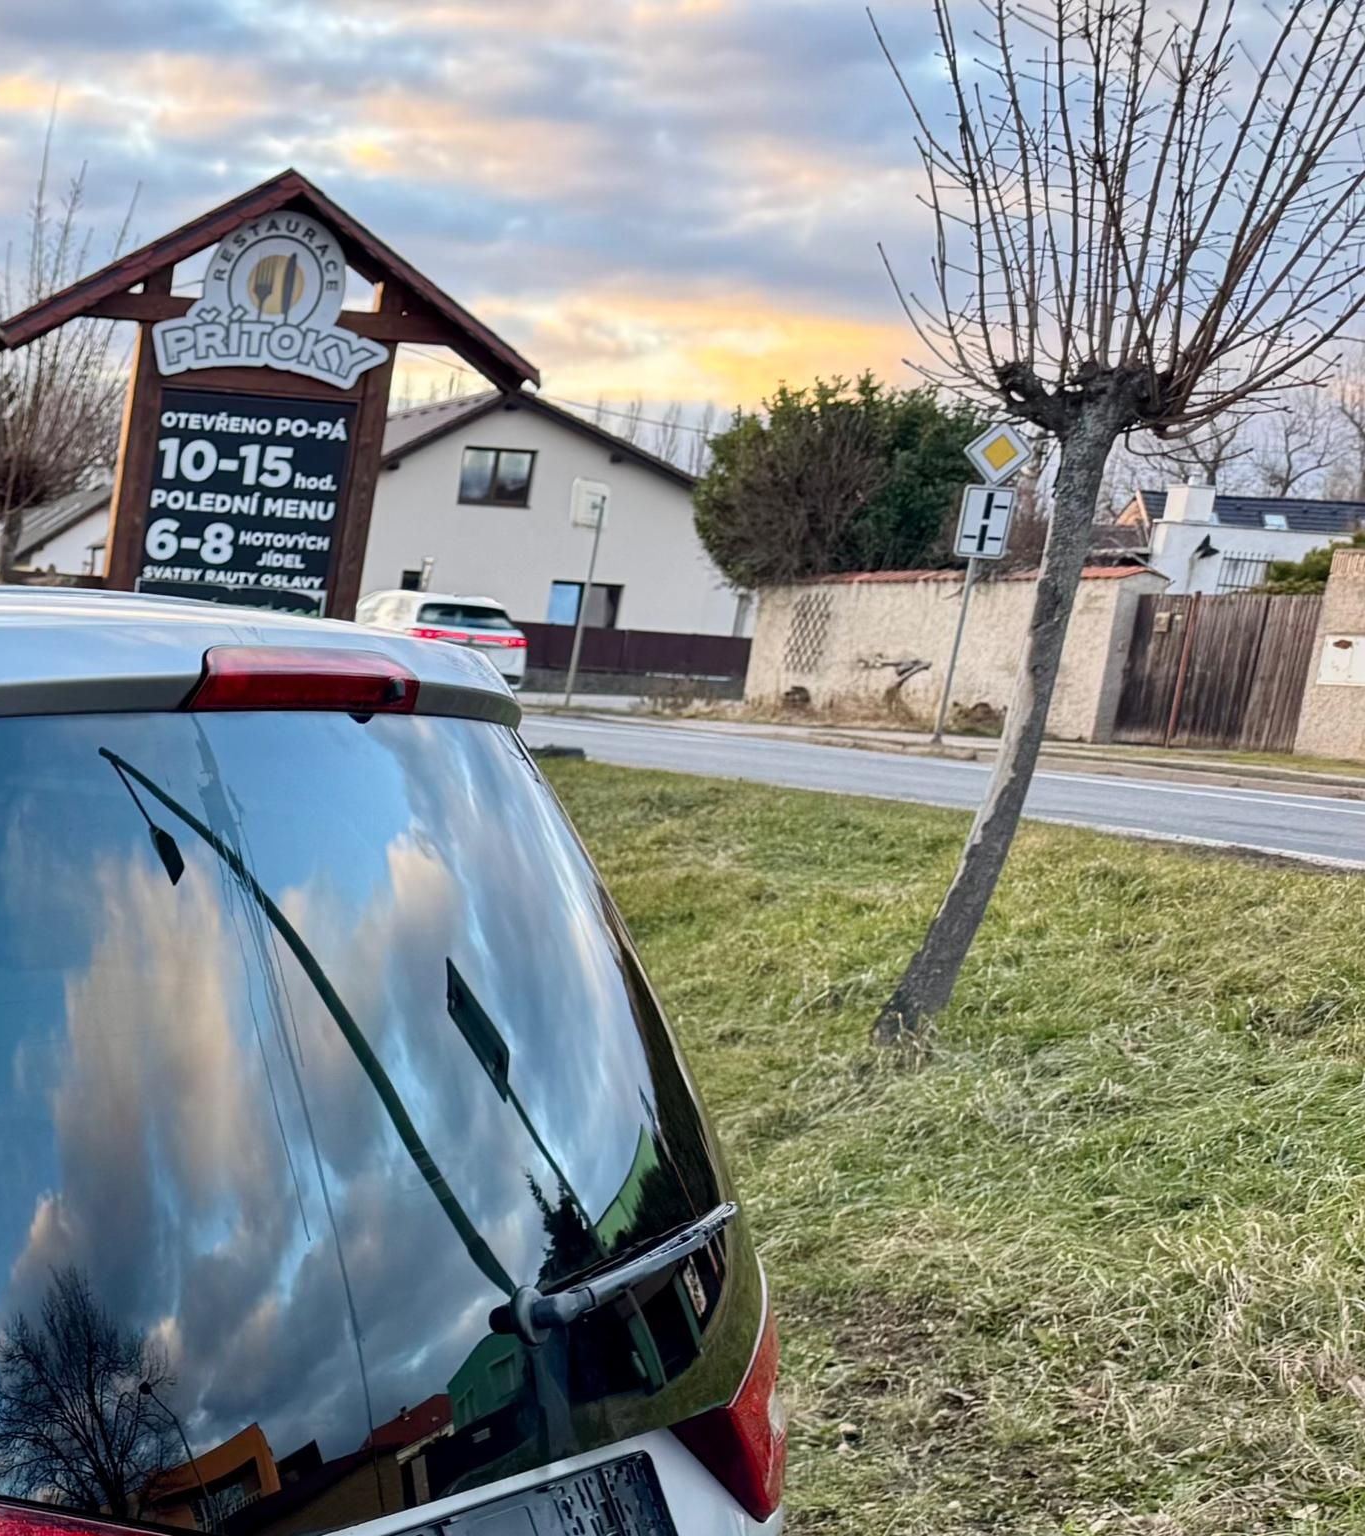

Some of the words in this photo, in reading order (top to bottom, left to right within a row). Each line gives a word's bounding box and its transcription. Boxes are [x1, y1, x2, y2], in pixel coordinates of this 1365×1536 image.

[213, 218, 339, 292] RESTAURACE
[161, 304, 381, 381] PŘÍTOKY
[160, 411, 272, 435] OTEVŘENO
[275, 418, 348, 441] PO-PÁ
[158, 437, 295, 488] 10-15
[293, 472, 338, 491] hod.
[150, 488, 261, 515] POLEDNÍ
[262, 497, 336, 521] MENU
[145, 517, 235, 565] 6-8
[238, 530, 331, 551] HOTOVÝCH
[256, 549, 306, 569] JÍDEL
[142, 565, 203, 581] SVATBY
[204, 569, 259, 586] RAUTY
[260, 573, 324, 590] OSLAVY
